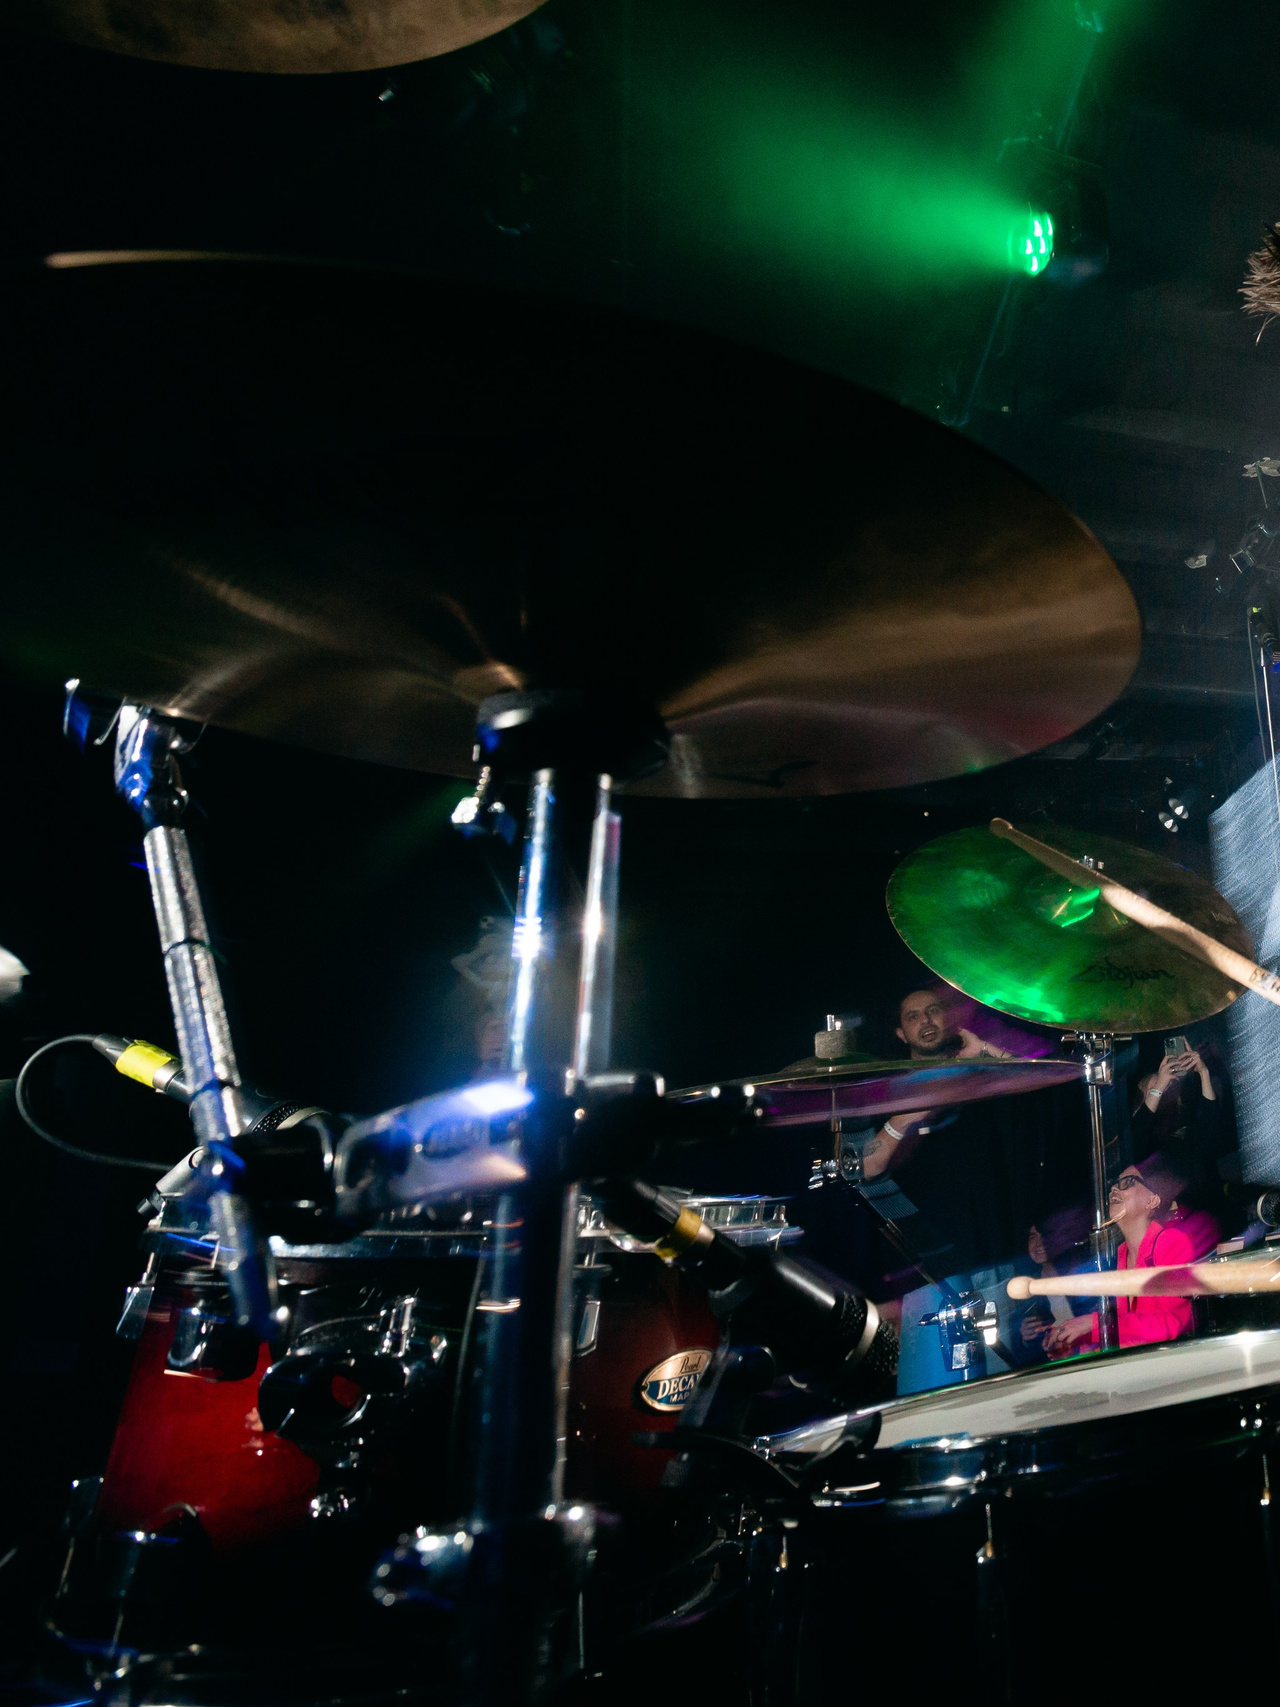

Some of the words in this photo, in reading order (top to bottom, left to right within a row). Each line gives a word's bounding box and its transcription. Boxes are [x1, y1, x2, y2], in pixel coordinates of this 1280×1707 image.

[680, 1355, 702, 1374] Pearl
[657, 1374, 700, 1400] DECA
[670, 1391, 690, 1402] MAP
